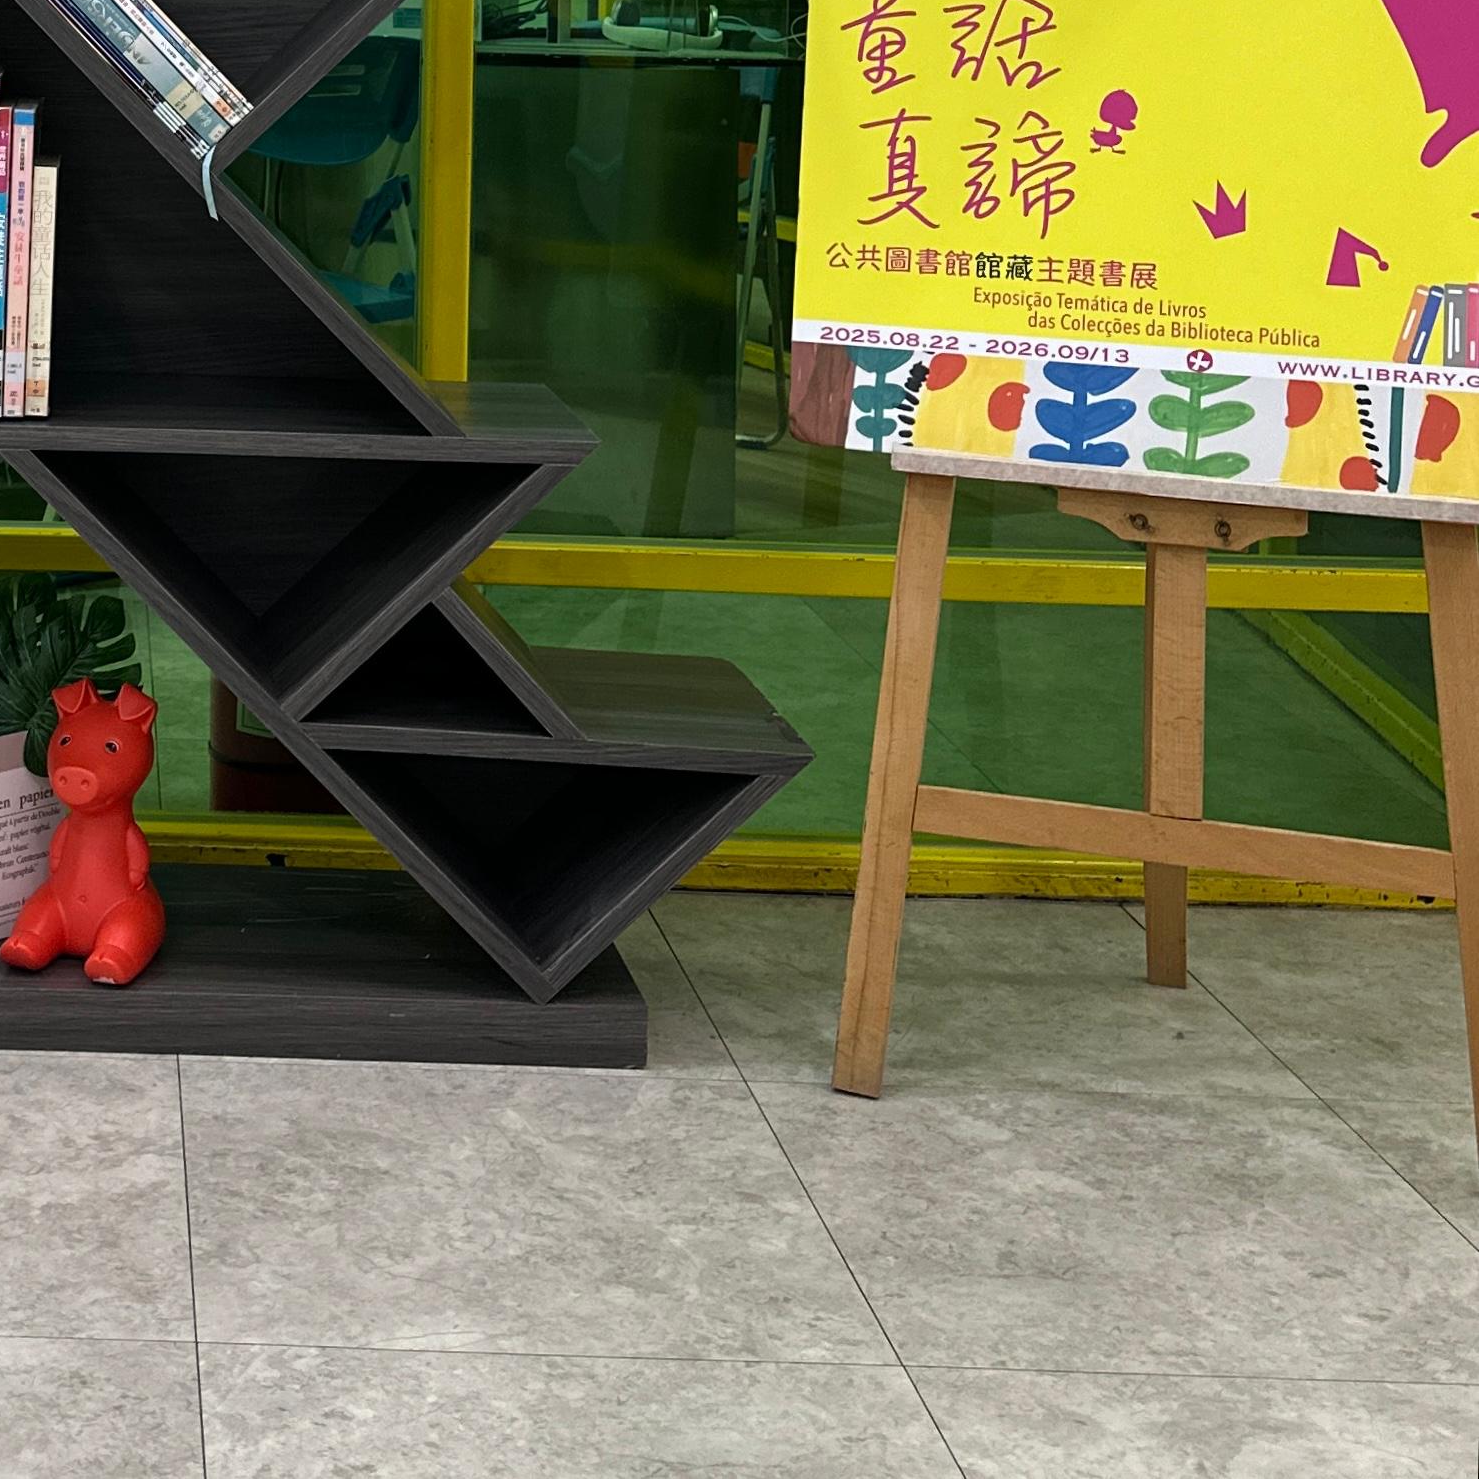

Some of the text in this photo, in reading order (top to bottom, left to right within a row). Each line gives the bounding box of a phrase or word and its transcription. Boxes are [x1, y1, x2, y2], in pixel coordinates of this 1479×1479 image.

[857, 108, 1076, 240] 真諦
[32, 189, 53, 297] 我的童话人生
[826, 242, 1158, 291] 公共圖書館館藏主題書展
[974, 287, 1207, 319] Exposição Temática de Livros
[820, 326, 959, 351] 2025.08.22
[985, 339, 1130, 363] 2026.09/13
[1028, 312, 1320, 349] das Colecções da Biblioteca Pública
